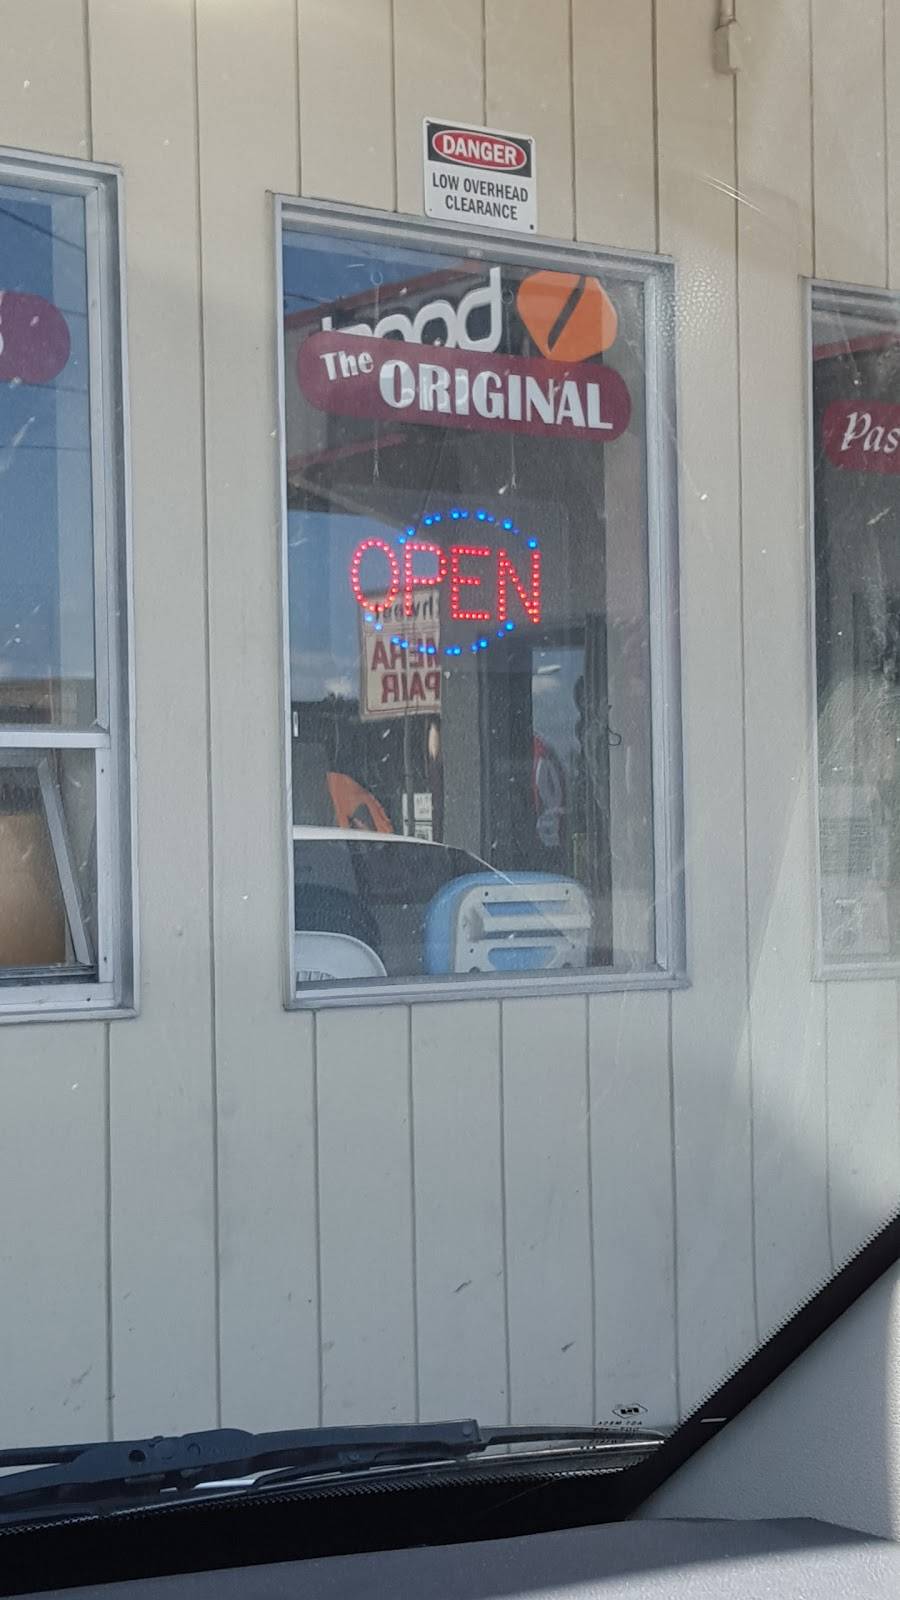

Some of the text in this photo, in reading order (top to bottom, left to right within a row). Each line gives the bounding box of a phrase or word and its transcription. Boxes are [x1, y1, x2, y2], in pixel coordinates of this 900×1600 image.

[442, 135, 517, 166] DANGER
[432, 172, 529, 203] LOW OVERHEAD
[445, 195, 518, 221] CLEARANCE
[320, 351, 613, 430] The ORIGINAL
[841, 411, 900, 454] Pas
[350, 538, 542, 624] OPEN
